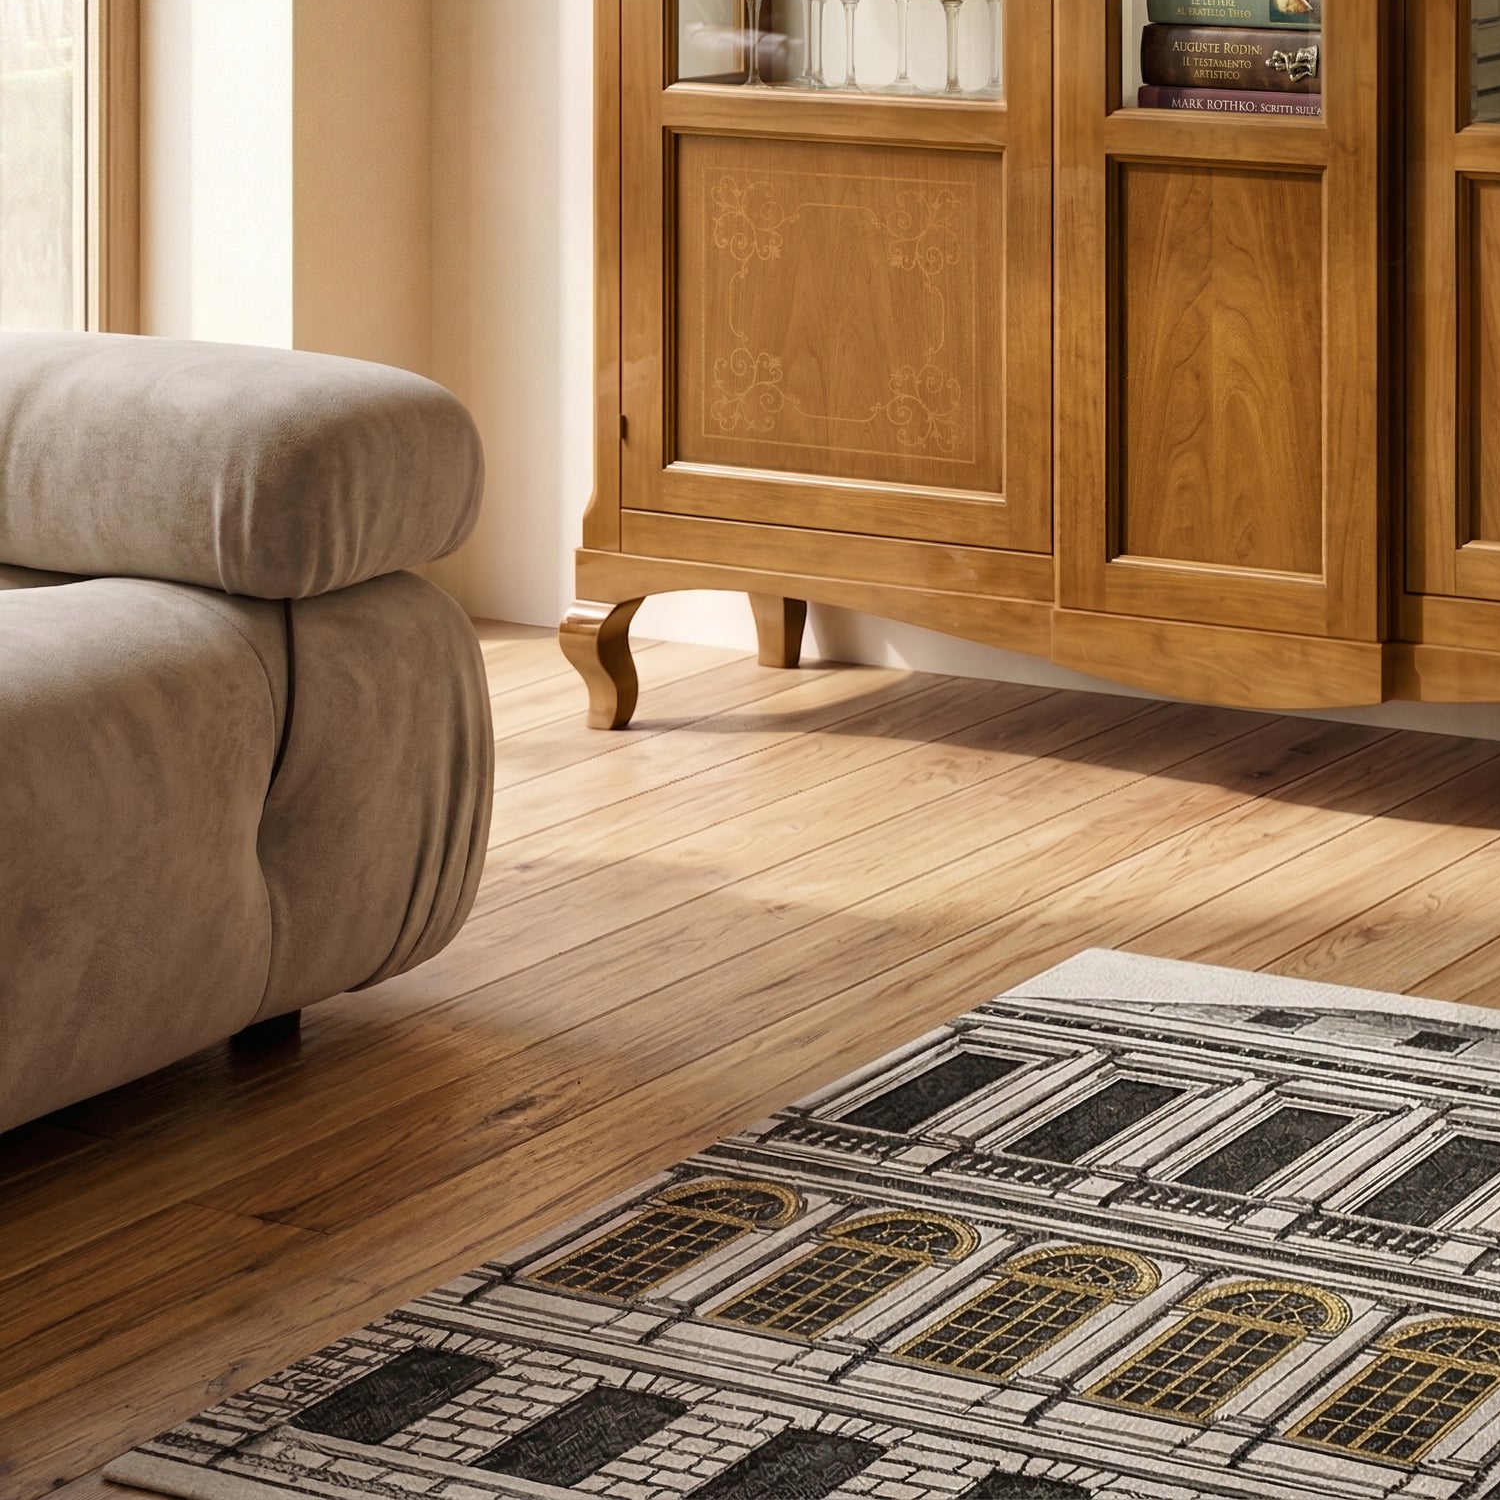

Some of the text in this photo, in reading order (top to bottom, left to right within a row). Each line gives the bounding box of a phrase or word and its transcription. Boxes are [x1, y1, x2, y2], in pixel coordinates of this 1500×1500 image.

[1176, 7, 1252, 19] AL FRATELLO THEO
[1172, 40, 1263, 55] AUGUSTE RODIN:
[1183, 56, 1252, 69] IL TESTAMENTO
[1193, 69, 1240, 80] ARTISTICO
[1171, 97, 1204, 110] MARK
[1207, 99, 1258, 112] ROTHKO:
[1260, 103, 1294, 114] SCRITTI
